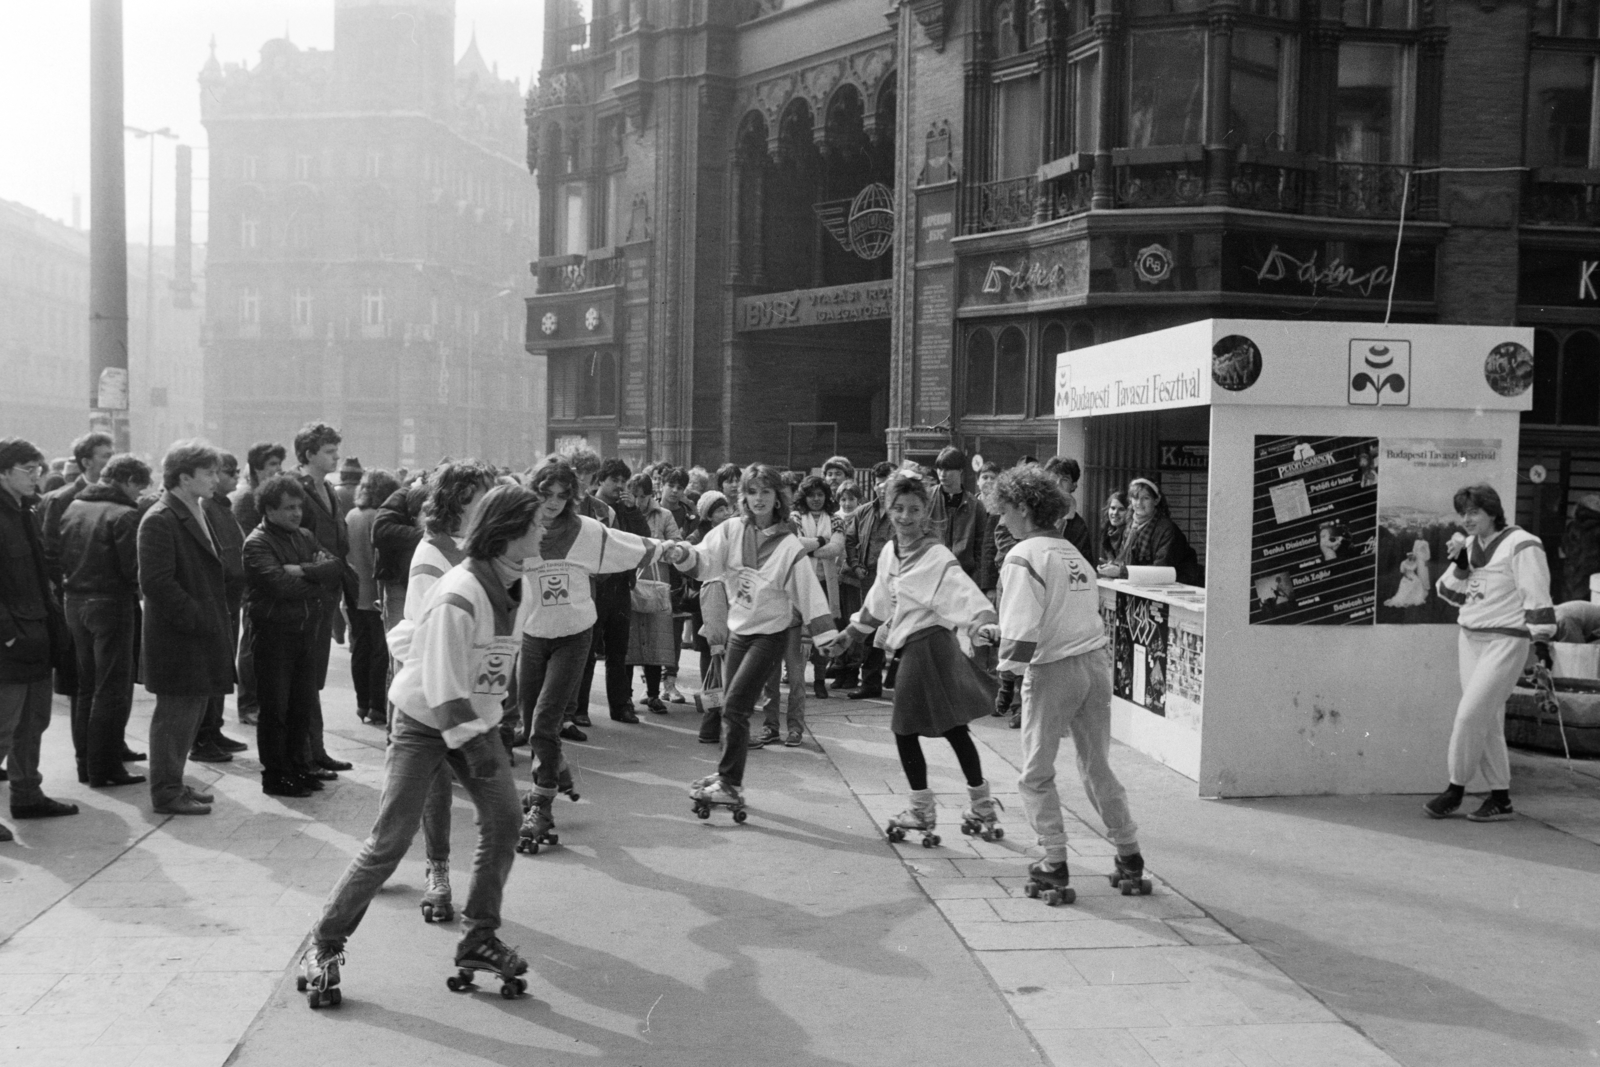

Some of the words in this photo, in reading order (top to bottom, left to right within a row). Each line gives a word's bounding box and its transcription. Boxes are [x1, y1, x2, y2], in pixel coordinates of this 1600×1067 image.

[1580, 260, 1599, 300] K
[1070, 384, 1110, 417] Budapesti
[1115, 378, 1149, 407] Tavaszi
[1153, 368, 1200, 403] Fesztivál
[1386, 449, 1427, 460] Budapesti
[1429, 450, 1458, 459] Tavaszi
[1461, 450, 1496, 460] Fesztivál
[1292, 576, 1310, 586] Rock
